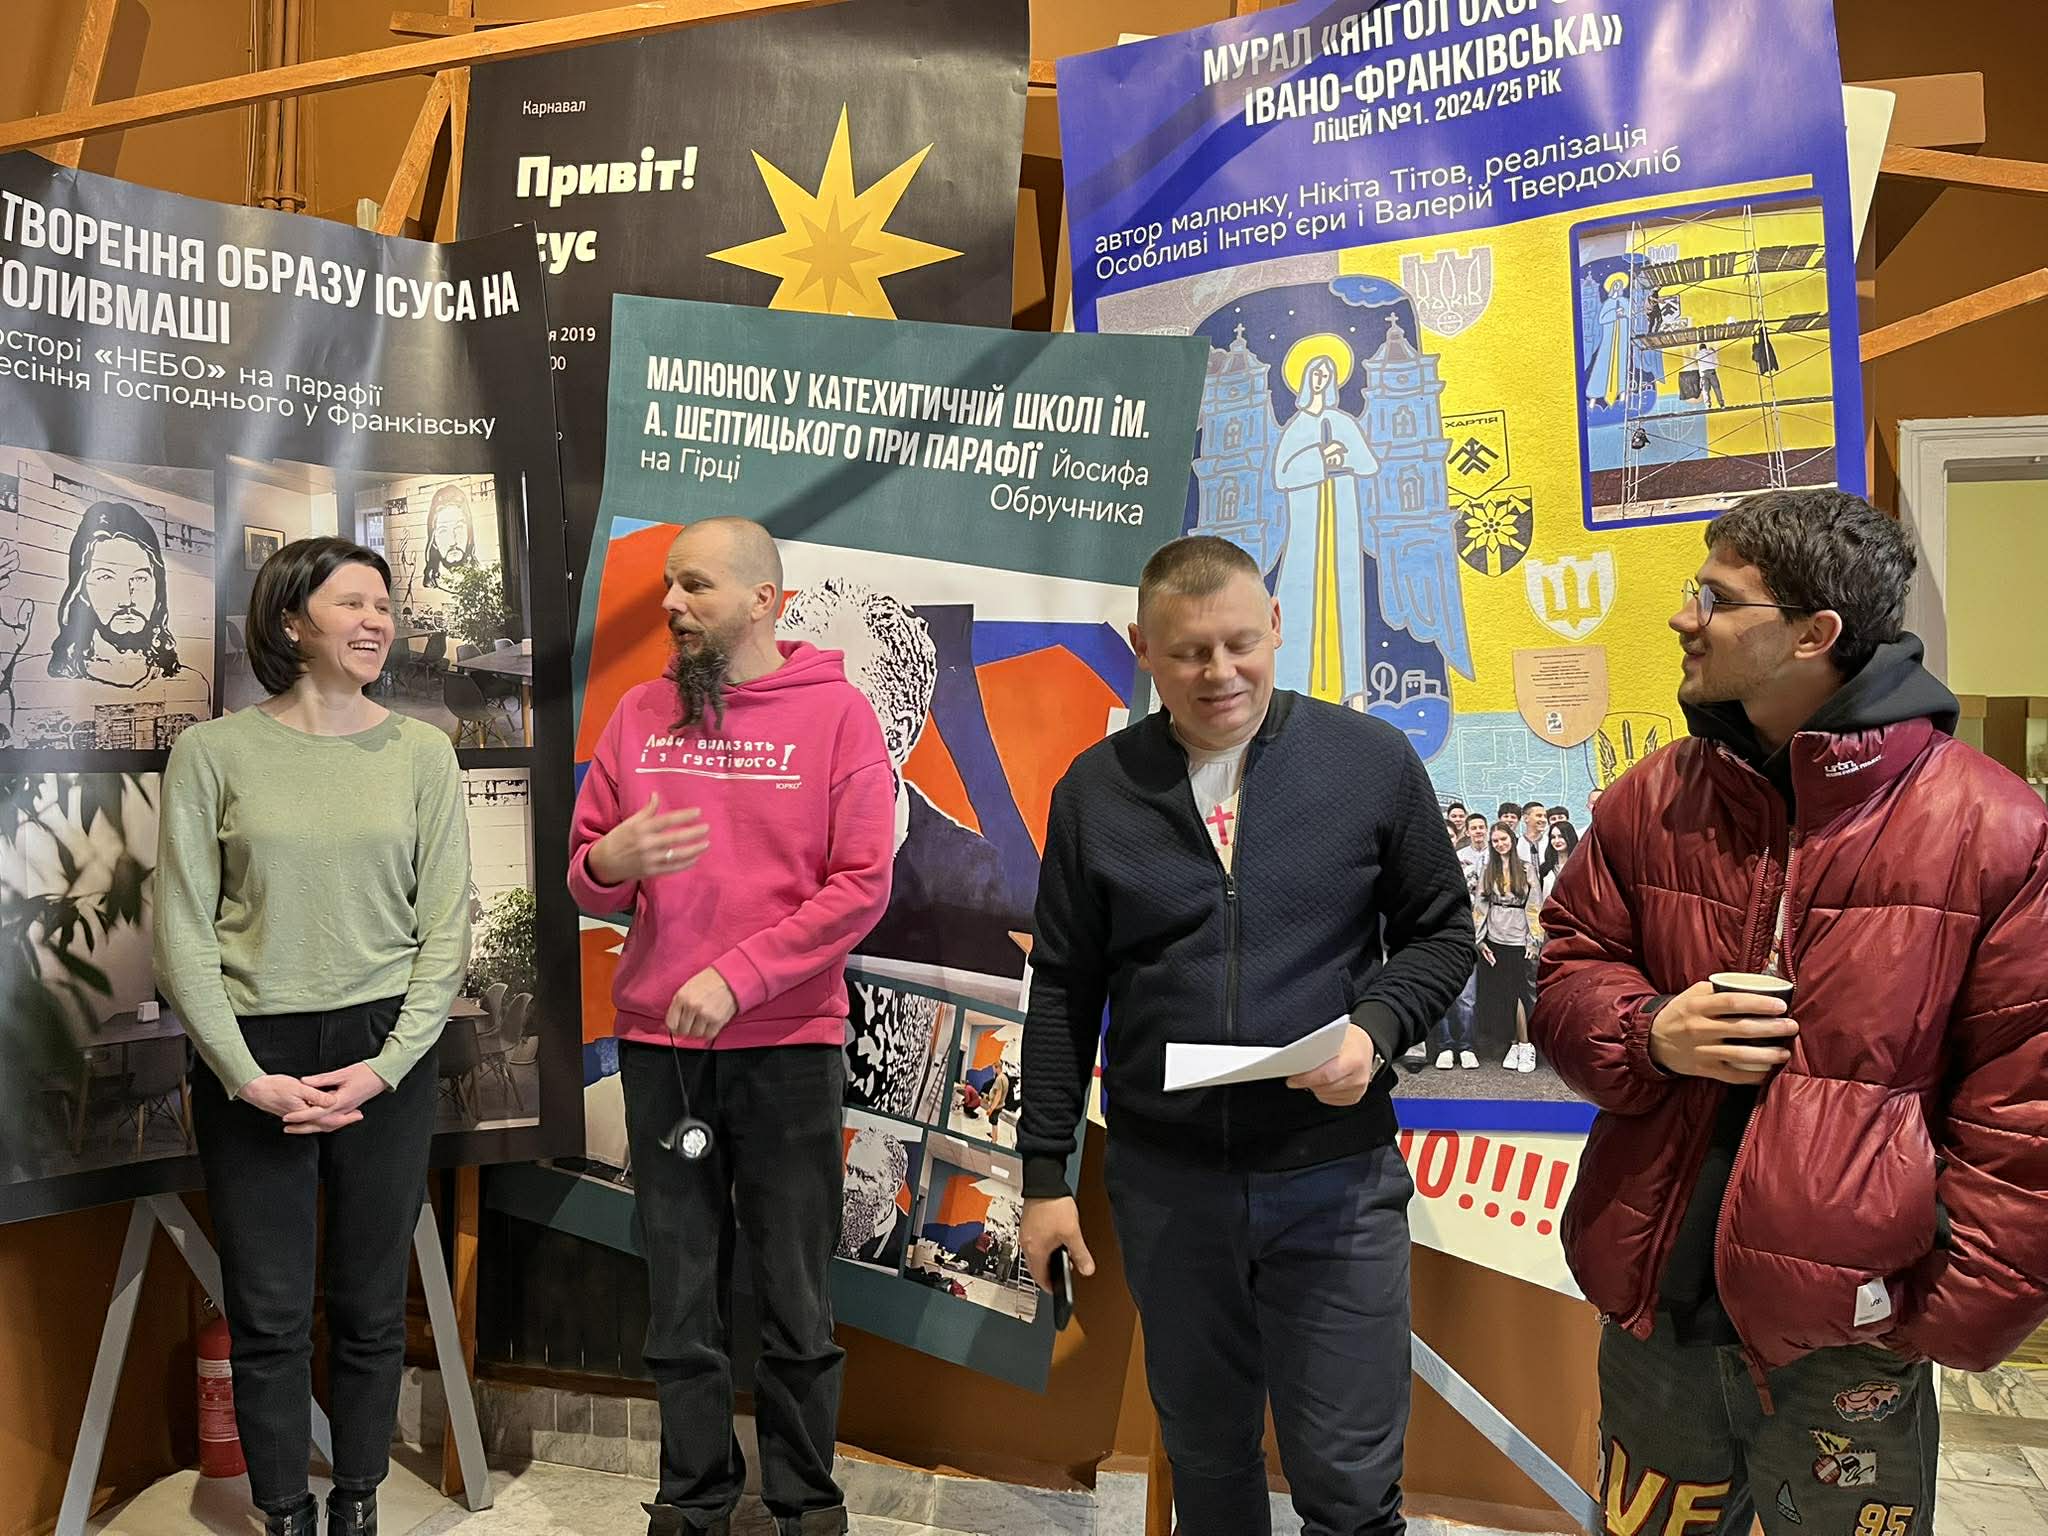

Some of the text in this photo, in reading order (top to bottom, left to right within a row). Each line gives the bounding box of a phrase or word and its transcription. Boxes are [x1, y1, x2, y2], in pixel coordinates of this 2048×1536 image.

[1203, 26, 1312, 86] МУРАЛ
[1320, 0, 1449, 57] «ЯНГОЛ
[1244, 14, 1623, 126] ІВАНО-ФРАНКІВСЬКА»
[523, 99, 586, 117] Карнавал
[1435, 80, 1521, 123] 2024/25
[517, 146, 698, 207] Привіт!
[1096, 219, 1162, 256] автор
[1300, 175, 1380, 208] Нікіта
[1390, 163, 1473, 194] Тітов,
[1486, 126, 1647, 186] реалізація
[1097, 237, 1209, 281] Особливі
[1358, 204, 1364, 227] і
[1375, 181, 1493, 225] Валерій
[1503, 146, 1682, 205] Твердохліб
[0, 257, 230, 345] ОЛИВМАШІ
[218, 244, 366, 308] ОБРАЗУ
[375, 273, 477, 323] ІСУСА
[483, 270, 520, 319] НА
[0, 328, 383, 408] сторі «НЕБО» на парафії
[561, 327, 596, 341] 2019
[104, 372, 294, 417] Господнього
[304, 405, 318, 426] у
[329, 402, 496, 439] Франківську
[647, 355, 776, 402] МАЛЮНОК
[782, 371, 801, 405] У
[808, 372, 1004, 428] КАТЕХИТИЧНІЙ
[1012, 395, 1104, 438] ШКОЛІ
[1445, 417, 1498, 428] ХАРТІЯ
[641, 447, 741, 482] на Гірці
[643, 402, 668, 437] А.
[674, 404, 862, 462] ШЕПТИЦЬКОГО
[866, 428, 918, 466] ПРИ
[1051, 446, 1149, 487] Йосифа
[990, 484, 1144, 526] Обручника
[1855, 1504, 1913, 1536] 95
